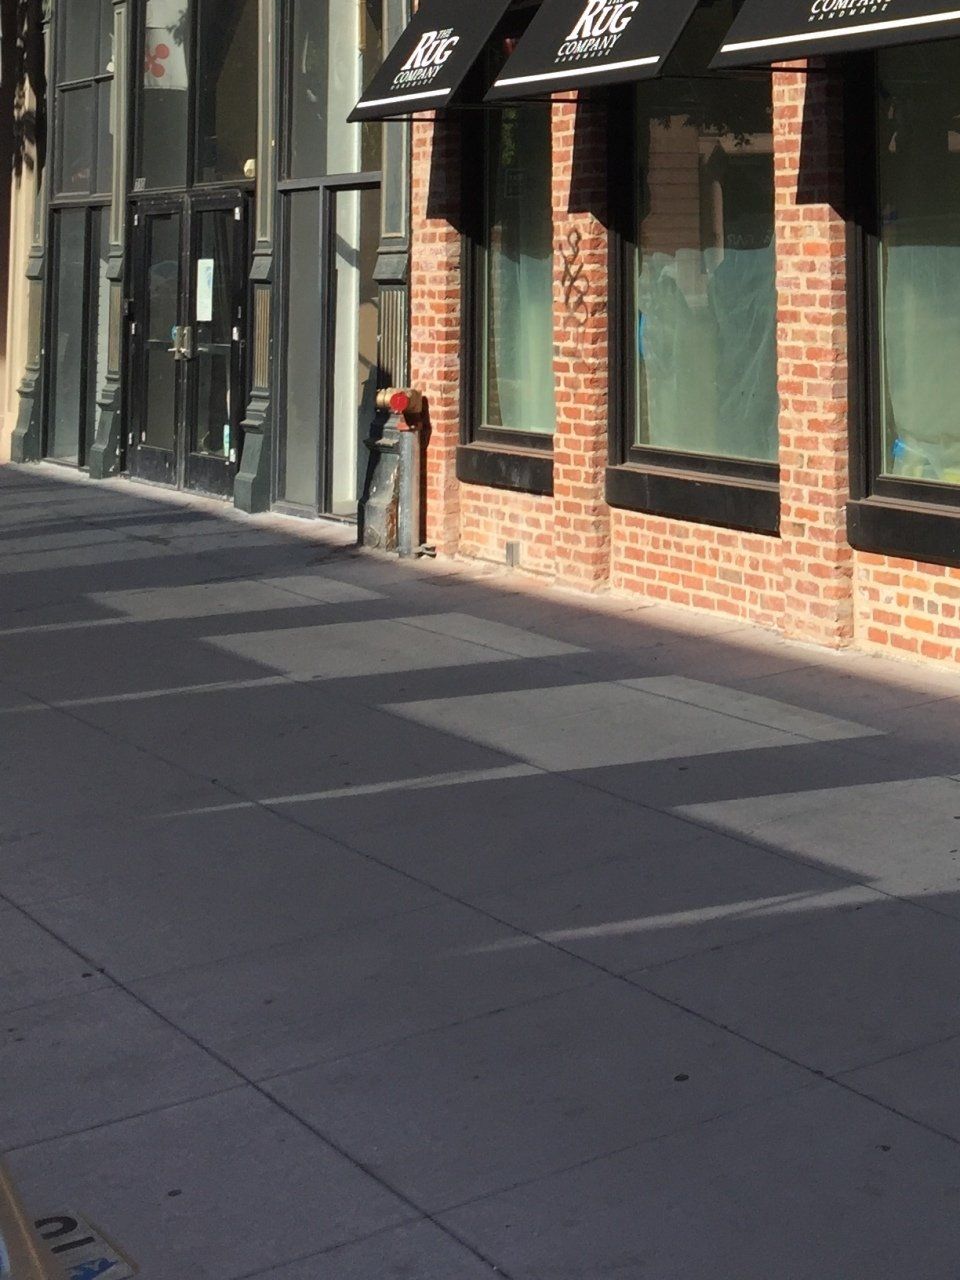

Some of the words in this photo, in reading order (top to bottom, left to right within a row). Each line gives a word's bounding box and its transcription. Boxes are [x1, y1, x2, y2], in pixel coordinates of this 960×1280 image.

[808, 3, 888, 22] HANDMADE
[436, 28, 453, 39] THE
[400, 31, 460, 70] RUG
[557, 33, 622, 56] COMPANY
[393, 64, 443, 84] COMPANY
